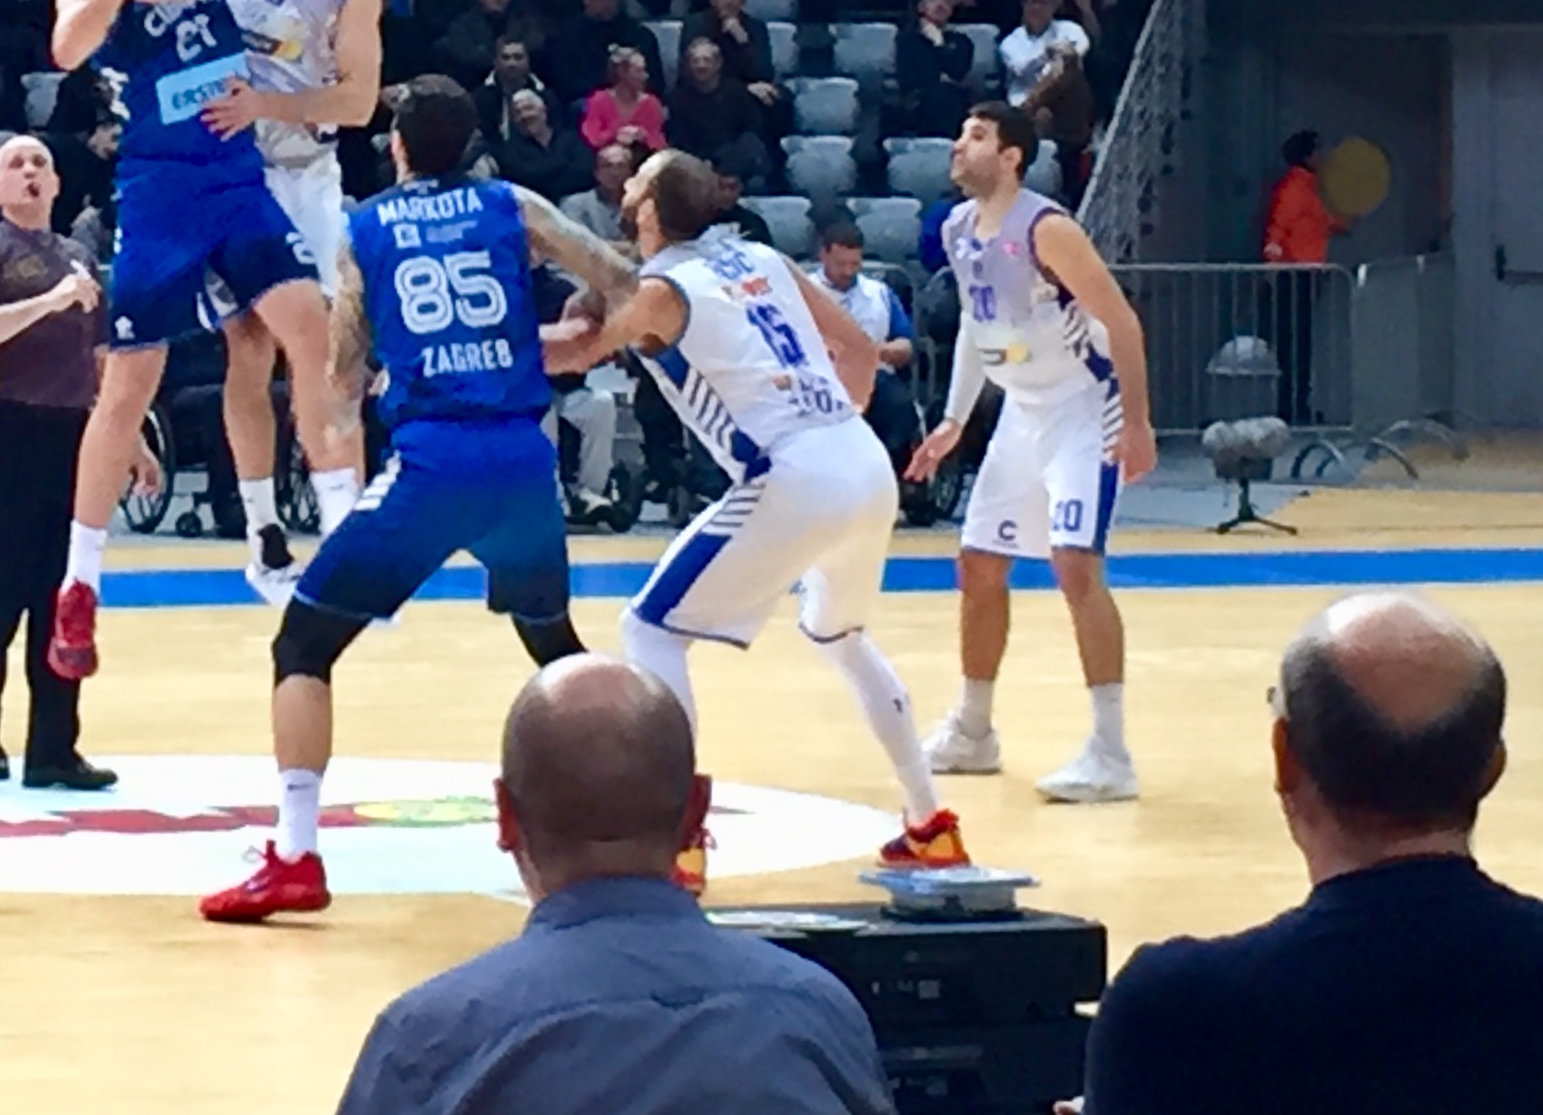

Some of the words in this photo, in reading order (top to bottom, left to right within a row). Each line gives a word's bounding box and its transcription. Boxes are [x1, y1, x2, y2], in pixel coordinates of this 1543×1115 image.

[377, 187, 484, 227] MARKOTA
[394, 249, 507, 335] 85
[421, 338, 514, 378] ZAGREB
